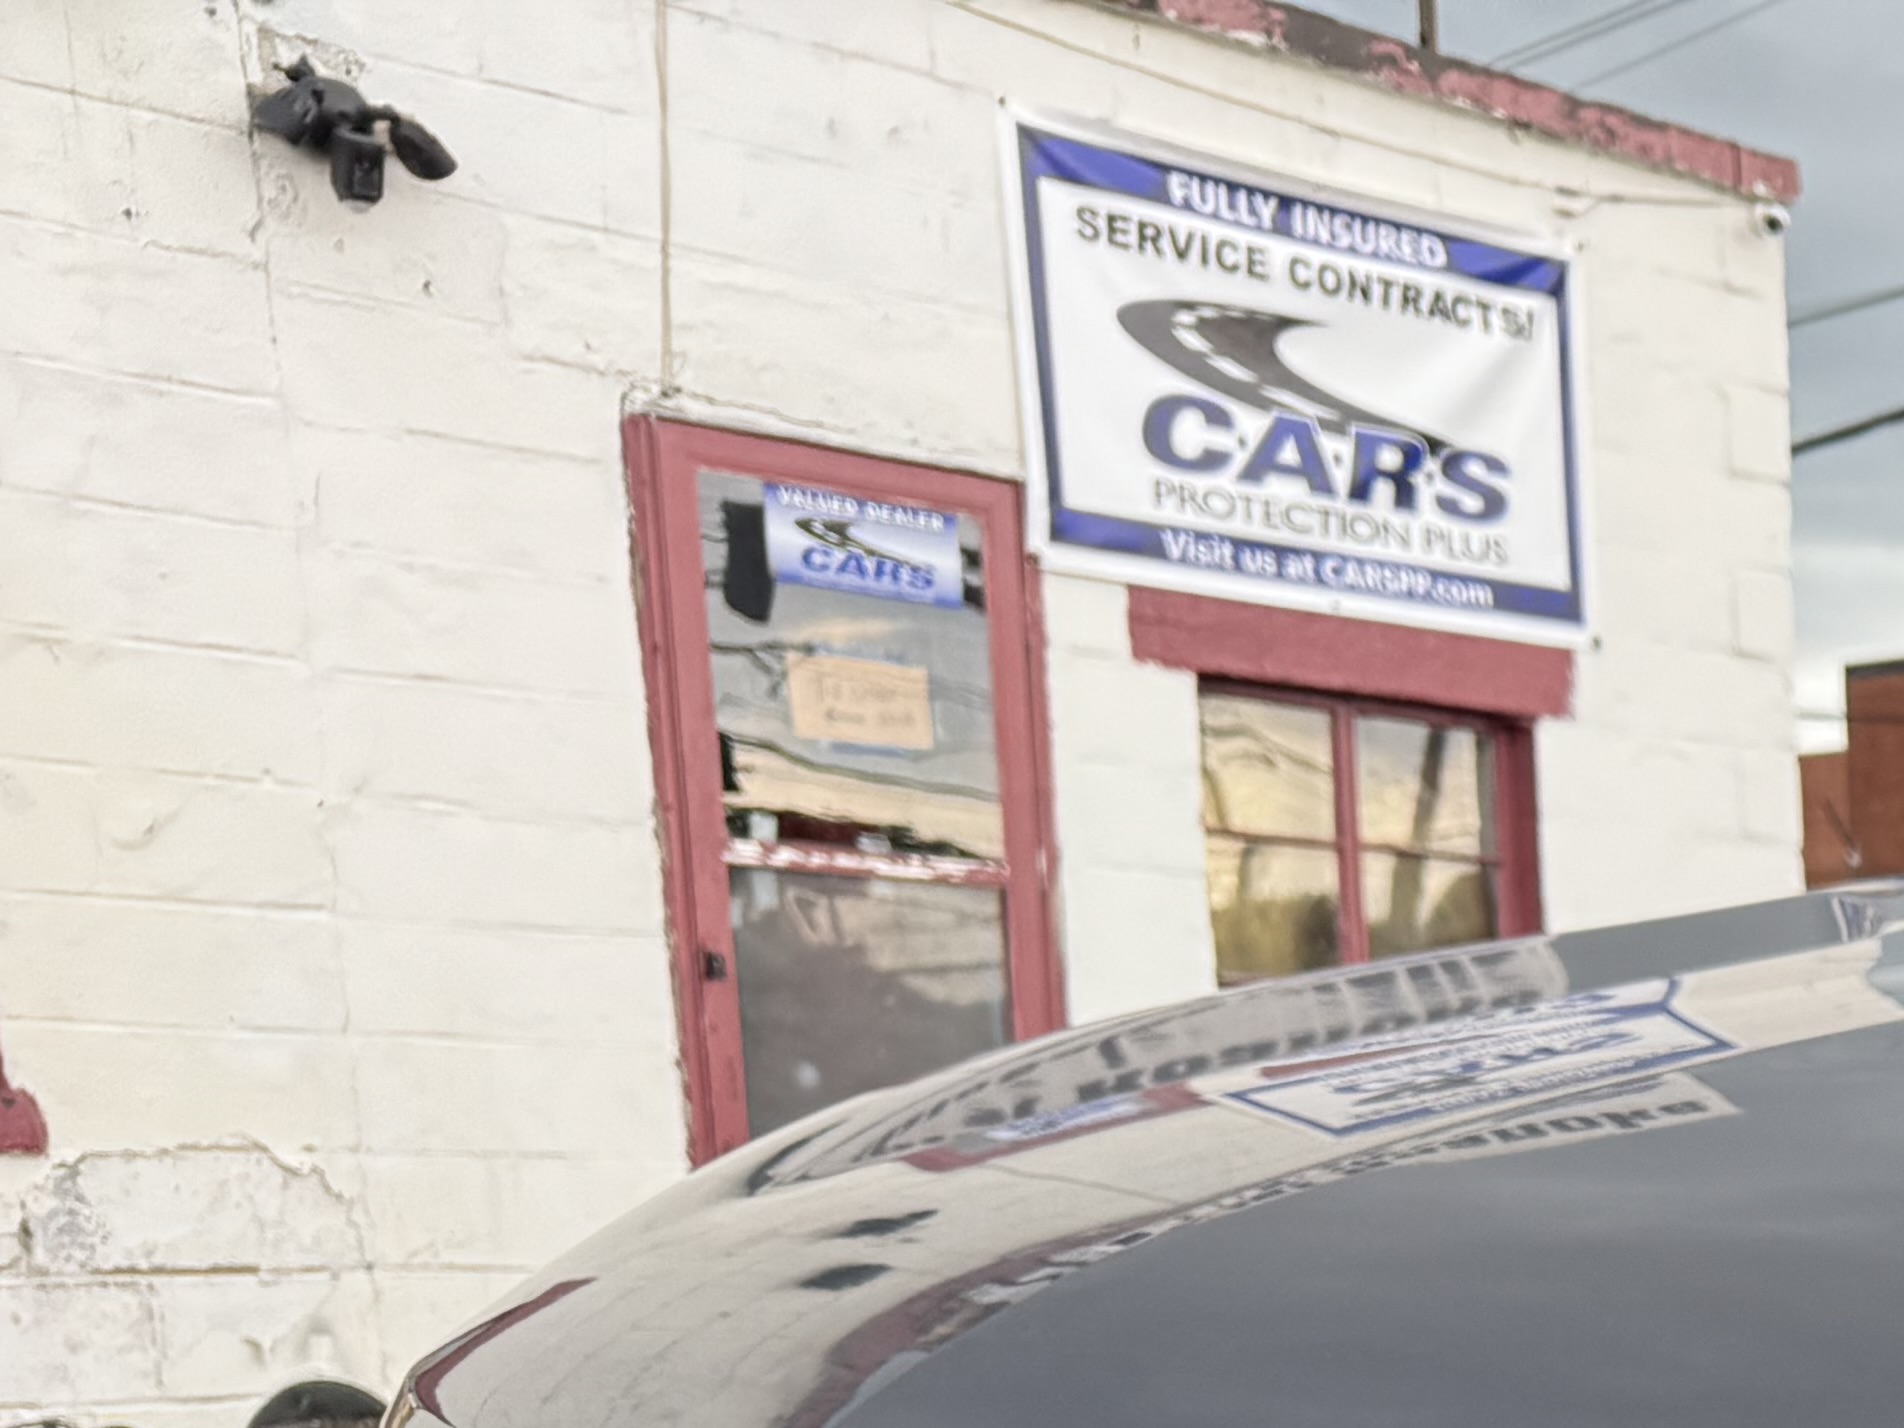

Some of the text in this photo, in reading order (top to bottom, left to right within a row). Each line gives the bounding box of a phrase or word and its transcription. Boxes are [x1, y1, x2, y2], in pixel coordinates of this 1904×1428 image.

[1167, 170, 1447, 268] FULLY INSURED
[1075, 205, 1535, 342] SERVICE CONTRACTS!
[775, 485, 945, 531] VALUED DEALER
[1153, 478, 1509, 563] PROTECTION PLUS
[1158, 527, 1495, 610] Visit us at CARSPP.com
